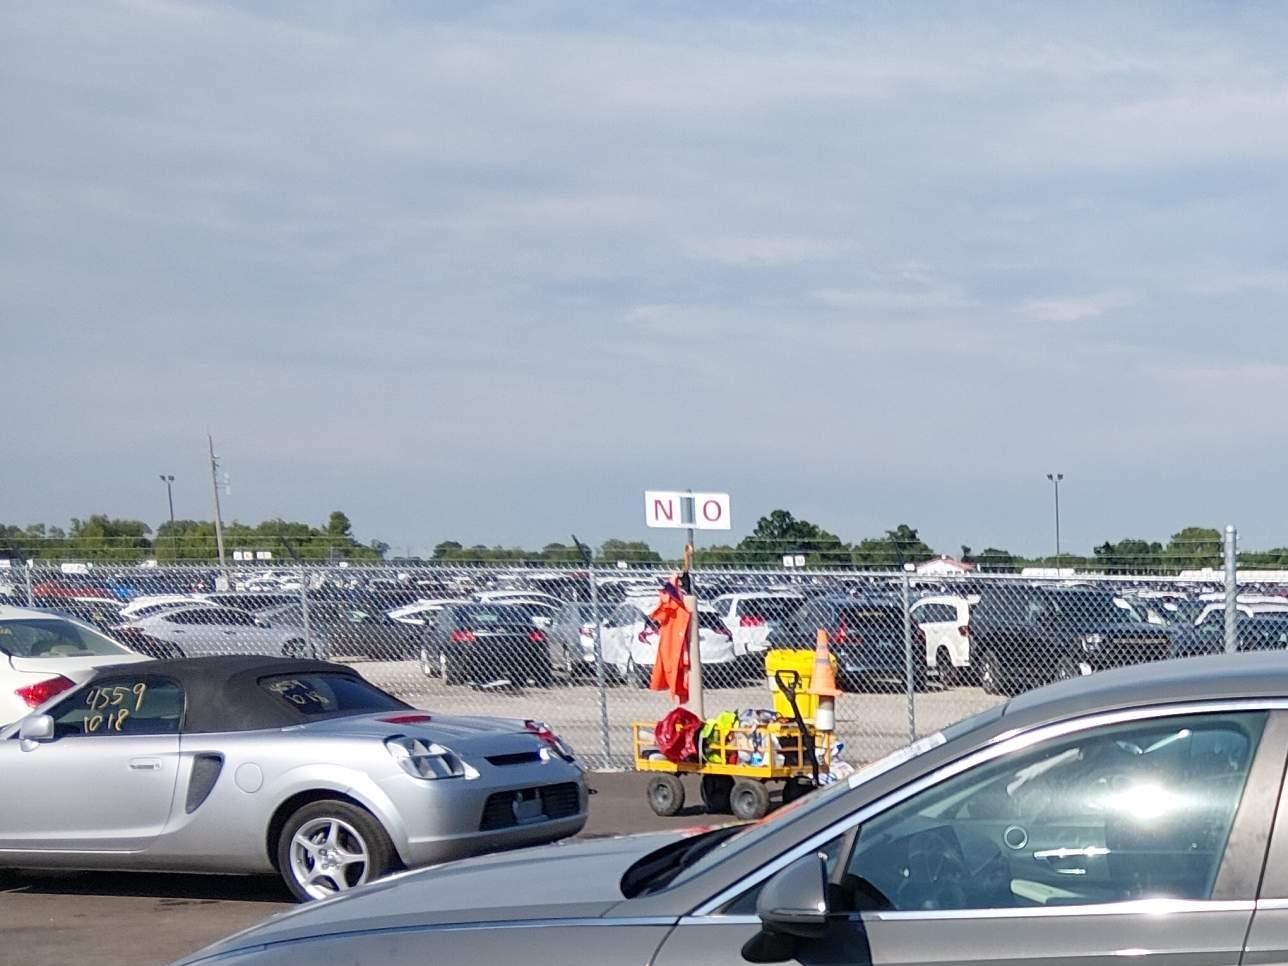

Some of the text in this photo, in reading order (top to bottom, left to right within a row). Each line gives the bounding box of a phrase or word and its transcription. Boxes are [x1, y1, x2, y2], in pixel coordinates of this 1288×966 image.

[654, 499, 722, 522] N O
[86, 683, 146, 711] 4559
[83, 708, 129, 734] 1018
